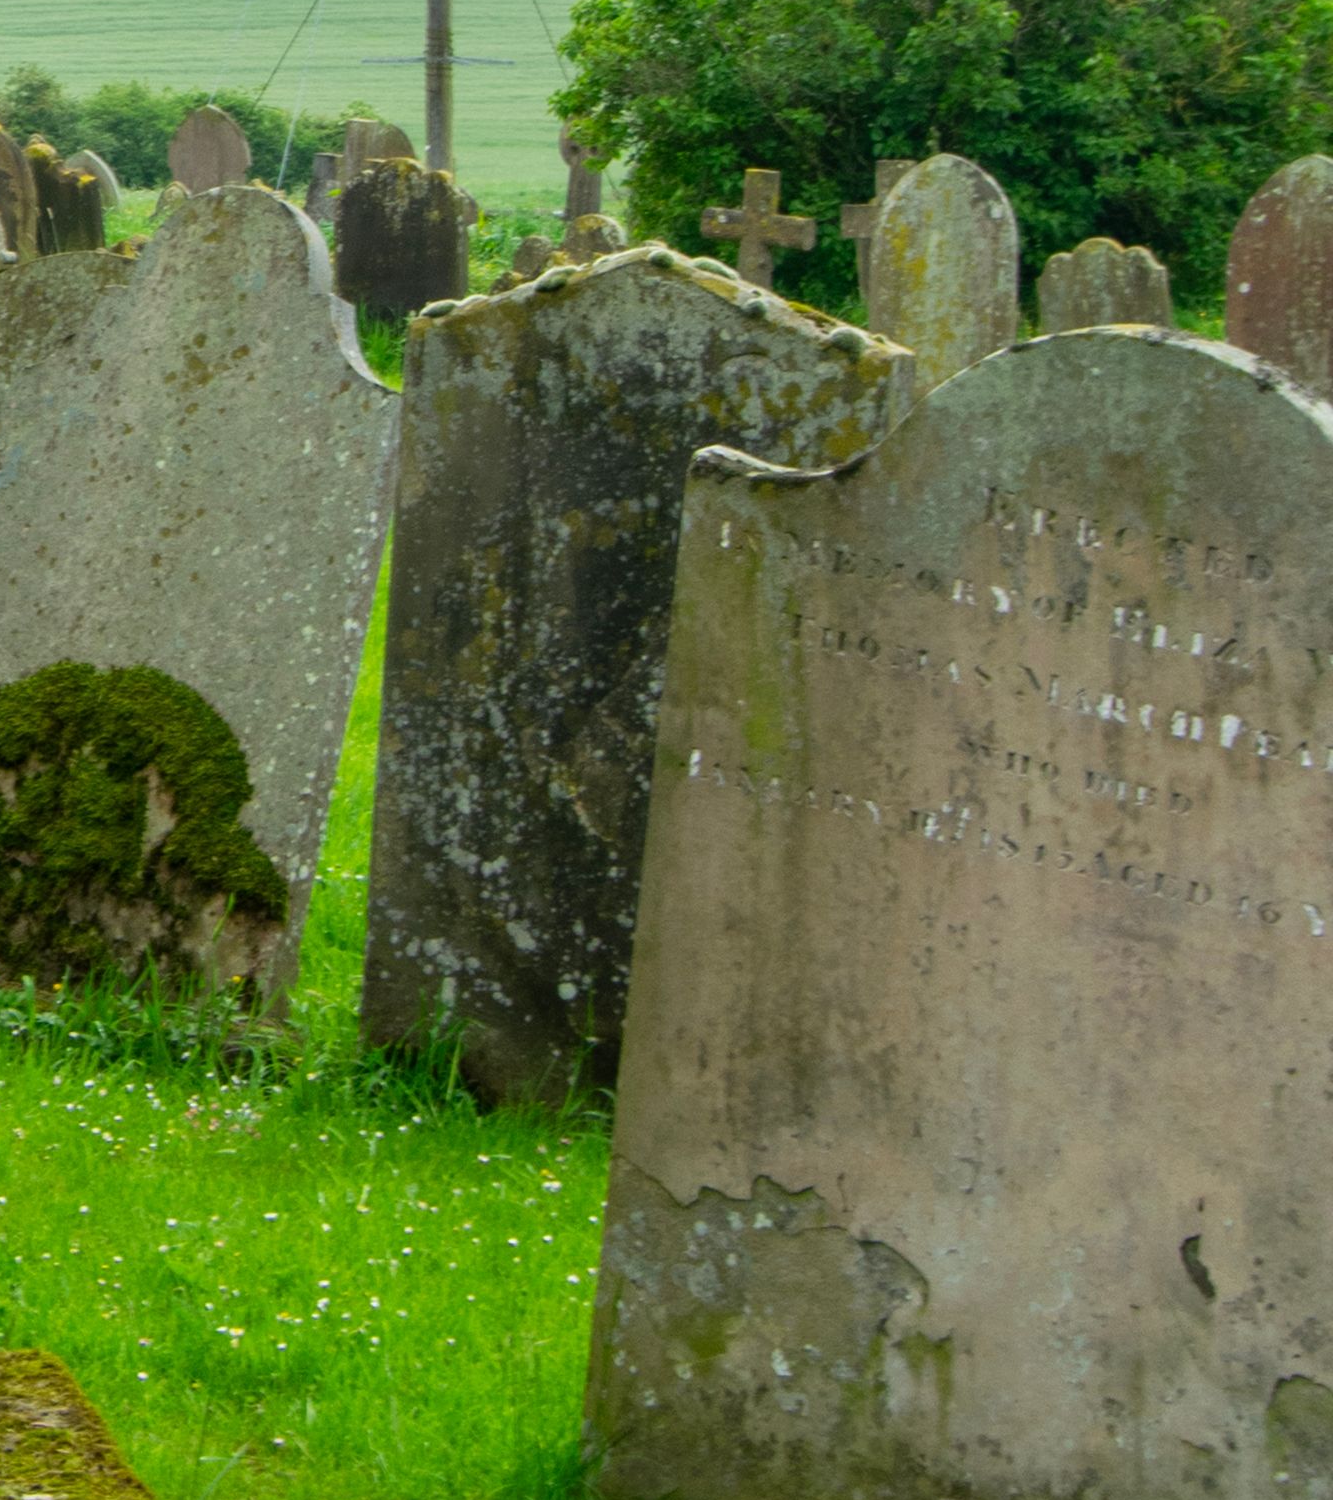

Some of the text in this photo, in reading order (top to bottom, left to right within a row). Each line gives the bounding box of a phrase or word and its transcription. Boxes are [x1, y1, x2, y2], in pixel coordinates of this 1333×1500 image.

[985, 486, 1277, 585] ERECTED
[788, 613, 995, 690] THOMAS
[1033, 594, 1091, 632] OF
[959, 735, 1193, 817] WHO DIED
[1091, 850, 1213, 906] AGED
